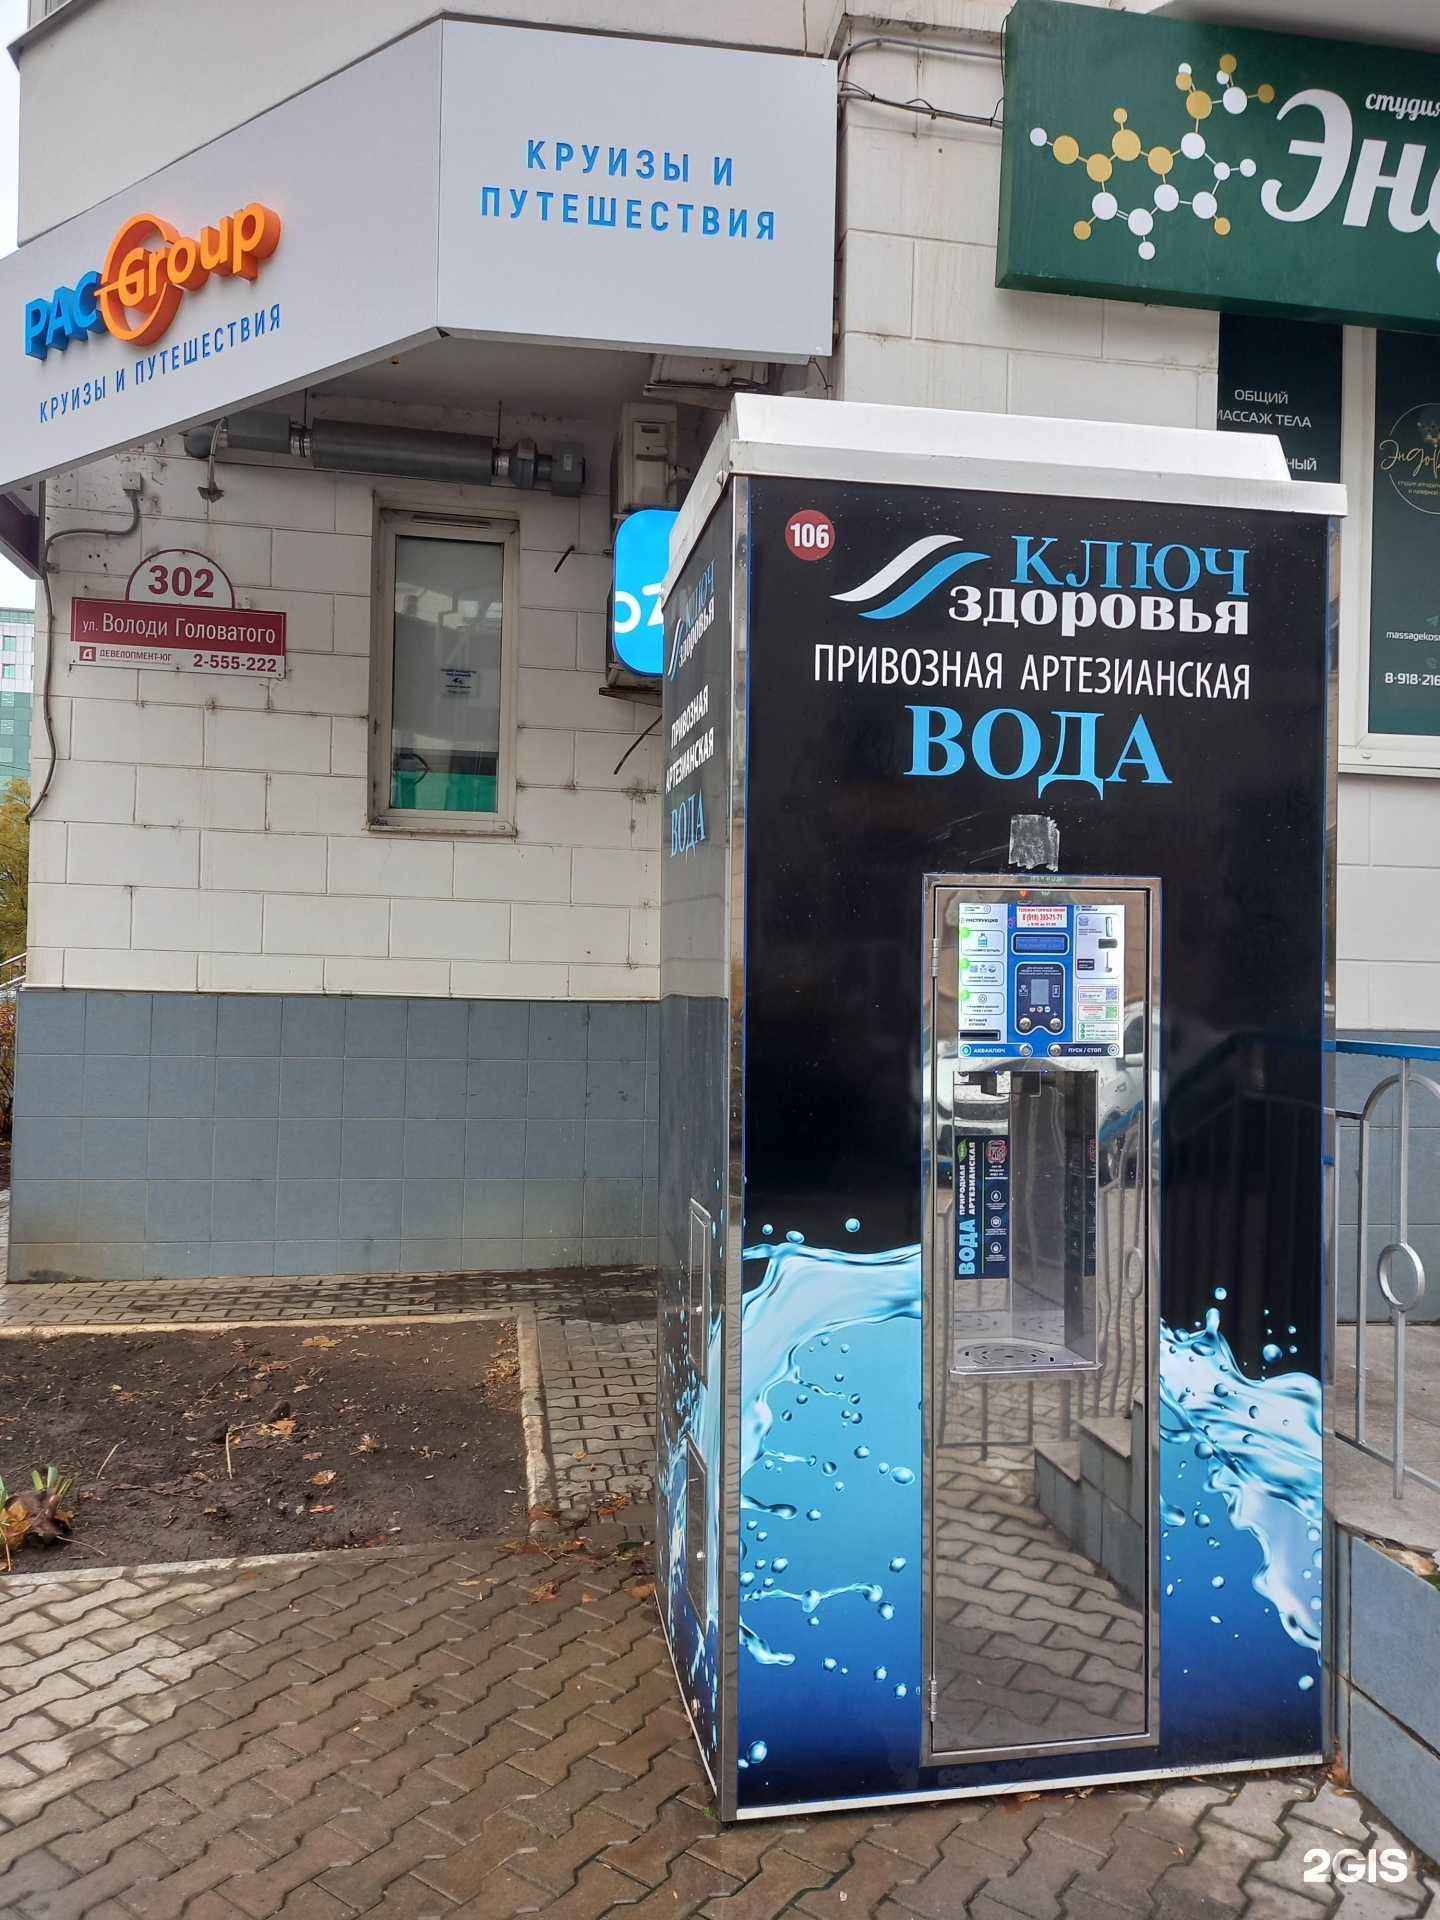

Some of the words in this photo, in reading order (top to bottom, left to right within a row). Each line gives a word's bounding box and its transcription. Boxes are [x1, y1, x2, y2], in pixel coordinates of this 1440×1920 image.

[527, 139, 689, 182] КРУИЗЫ
[713, 157, 733, 187] И
[1261, 88, 1440, 274] Эн
[481, 187, 774, 241] ПУТЕШЕСТВИЯ
[25, 271, 107, 360] PAC
[100, 203, 281, 318] Group
[40, 375, 106, 423] КРУИЗЫ
[116, 368, 125, 393] И
[135, 303, 281, 386] ПУТЕШЕСТВИЯ
[1234, 389, 1289, 405] ОБЩИЙ
[1275, 413, 1312, 428] ТЕЛА
[790, 522, 830, 550] 106
[148, 565, 214, 598] 302
[1010, 535, 1250, 596] КЛЮЧ
[82, 619, 99, 633] ул.
[102, 613, 168, 639] Володи
[175, 618, 276, 644] Головатого
[679, 596, 715, 668] здоровья
[948, 585, 1249, 637] здоровья
[193, 653, 277, 673] 2-555-222
[814, 643, 1003, 690] ПРИВОЗНАЯ
[1020, 655, 1251, 701] АРТЕЗИАНСКАЯ
[671, 684, 709, 750] ПРИВОЗНАЯ
[665, 727, 715, 795] АРТЕЗИАНСКАЯ
[903, 705, 1173, 800] ВОДА
[670, 788, 706, 863] ВОДА
[968, 1142, 976, 1215] АРТЕЗИАНСКАЯ
[958, 1219, 978, 1275] ВОДА
